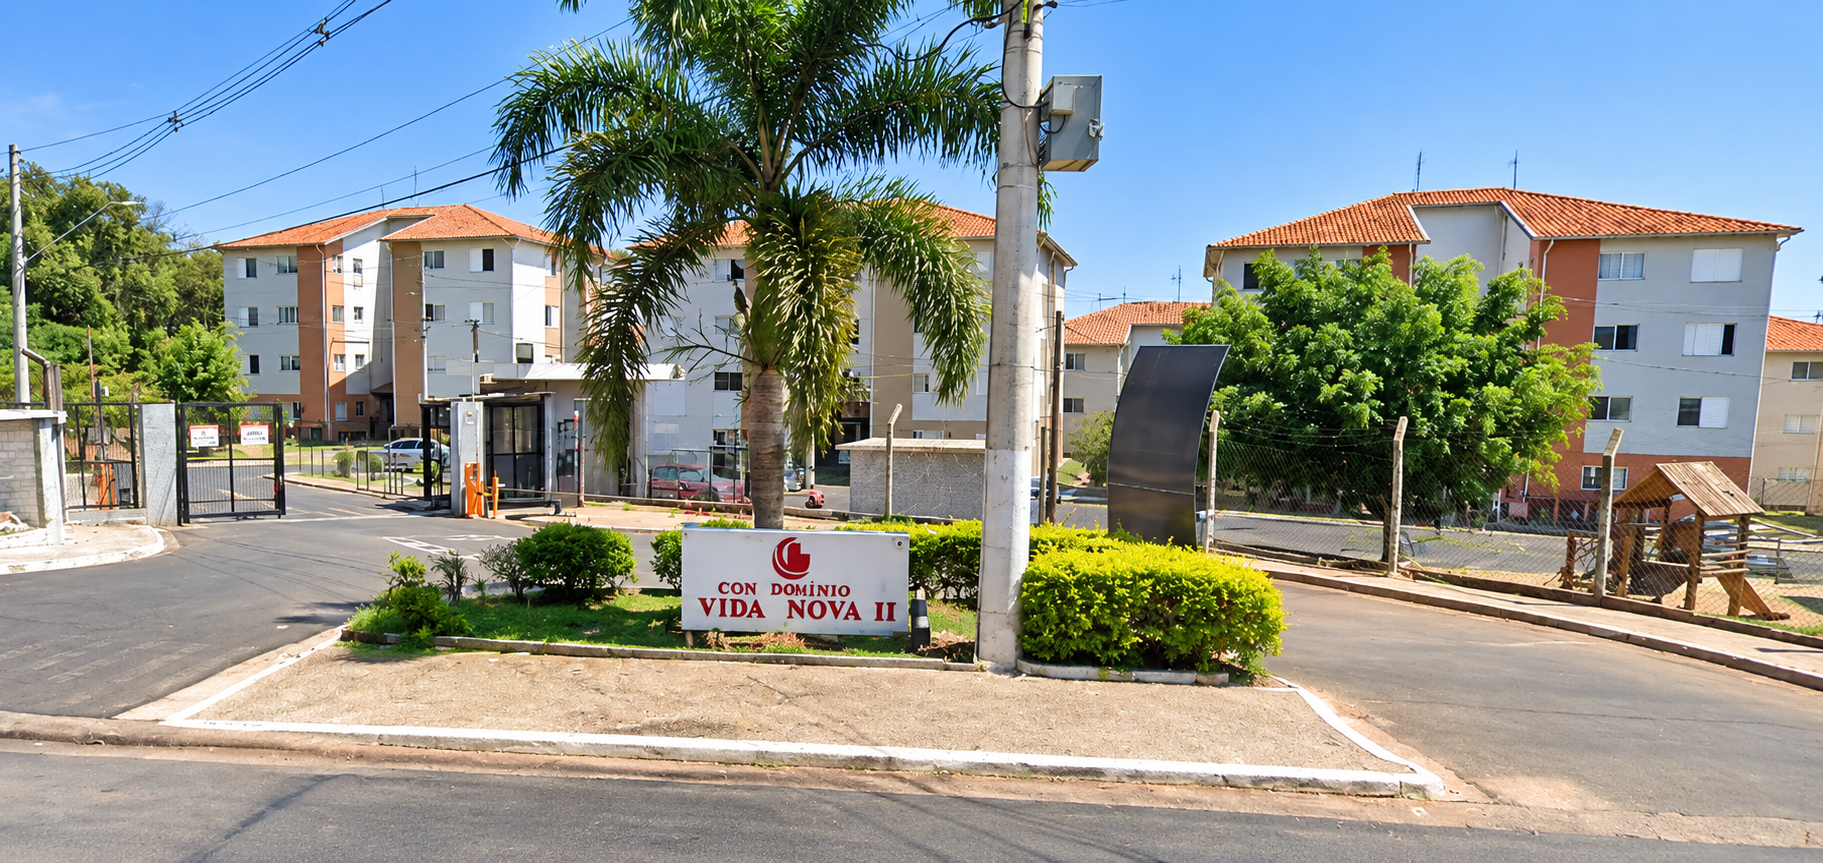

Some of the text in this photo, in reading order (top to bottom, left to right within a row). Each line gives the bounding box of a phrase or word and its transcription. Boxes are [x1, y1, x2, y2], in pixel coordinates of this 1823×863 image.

[717, 581, 757, 596] CON
[698, 597, 897, 622] VIDA NOVA II
